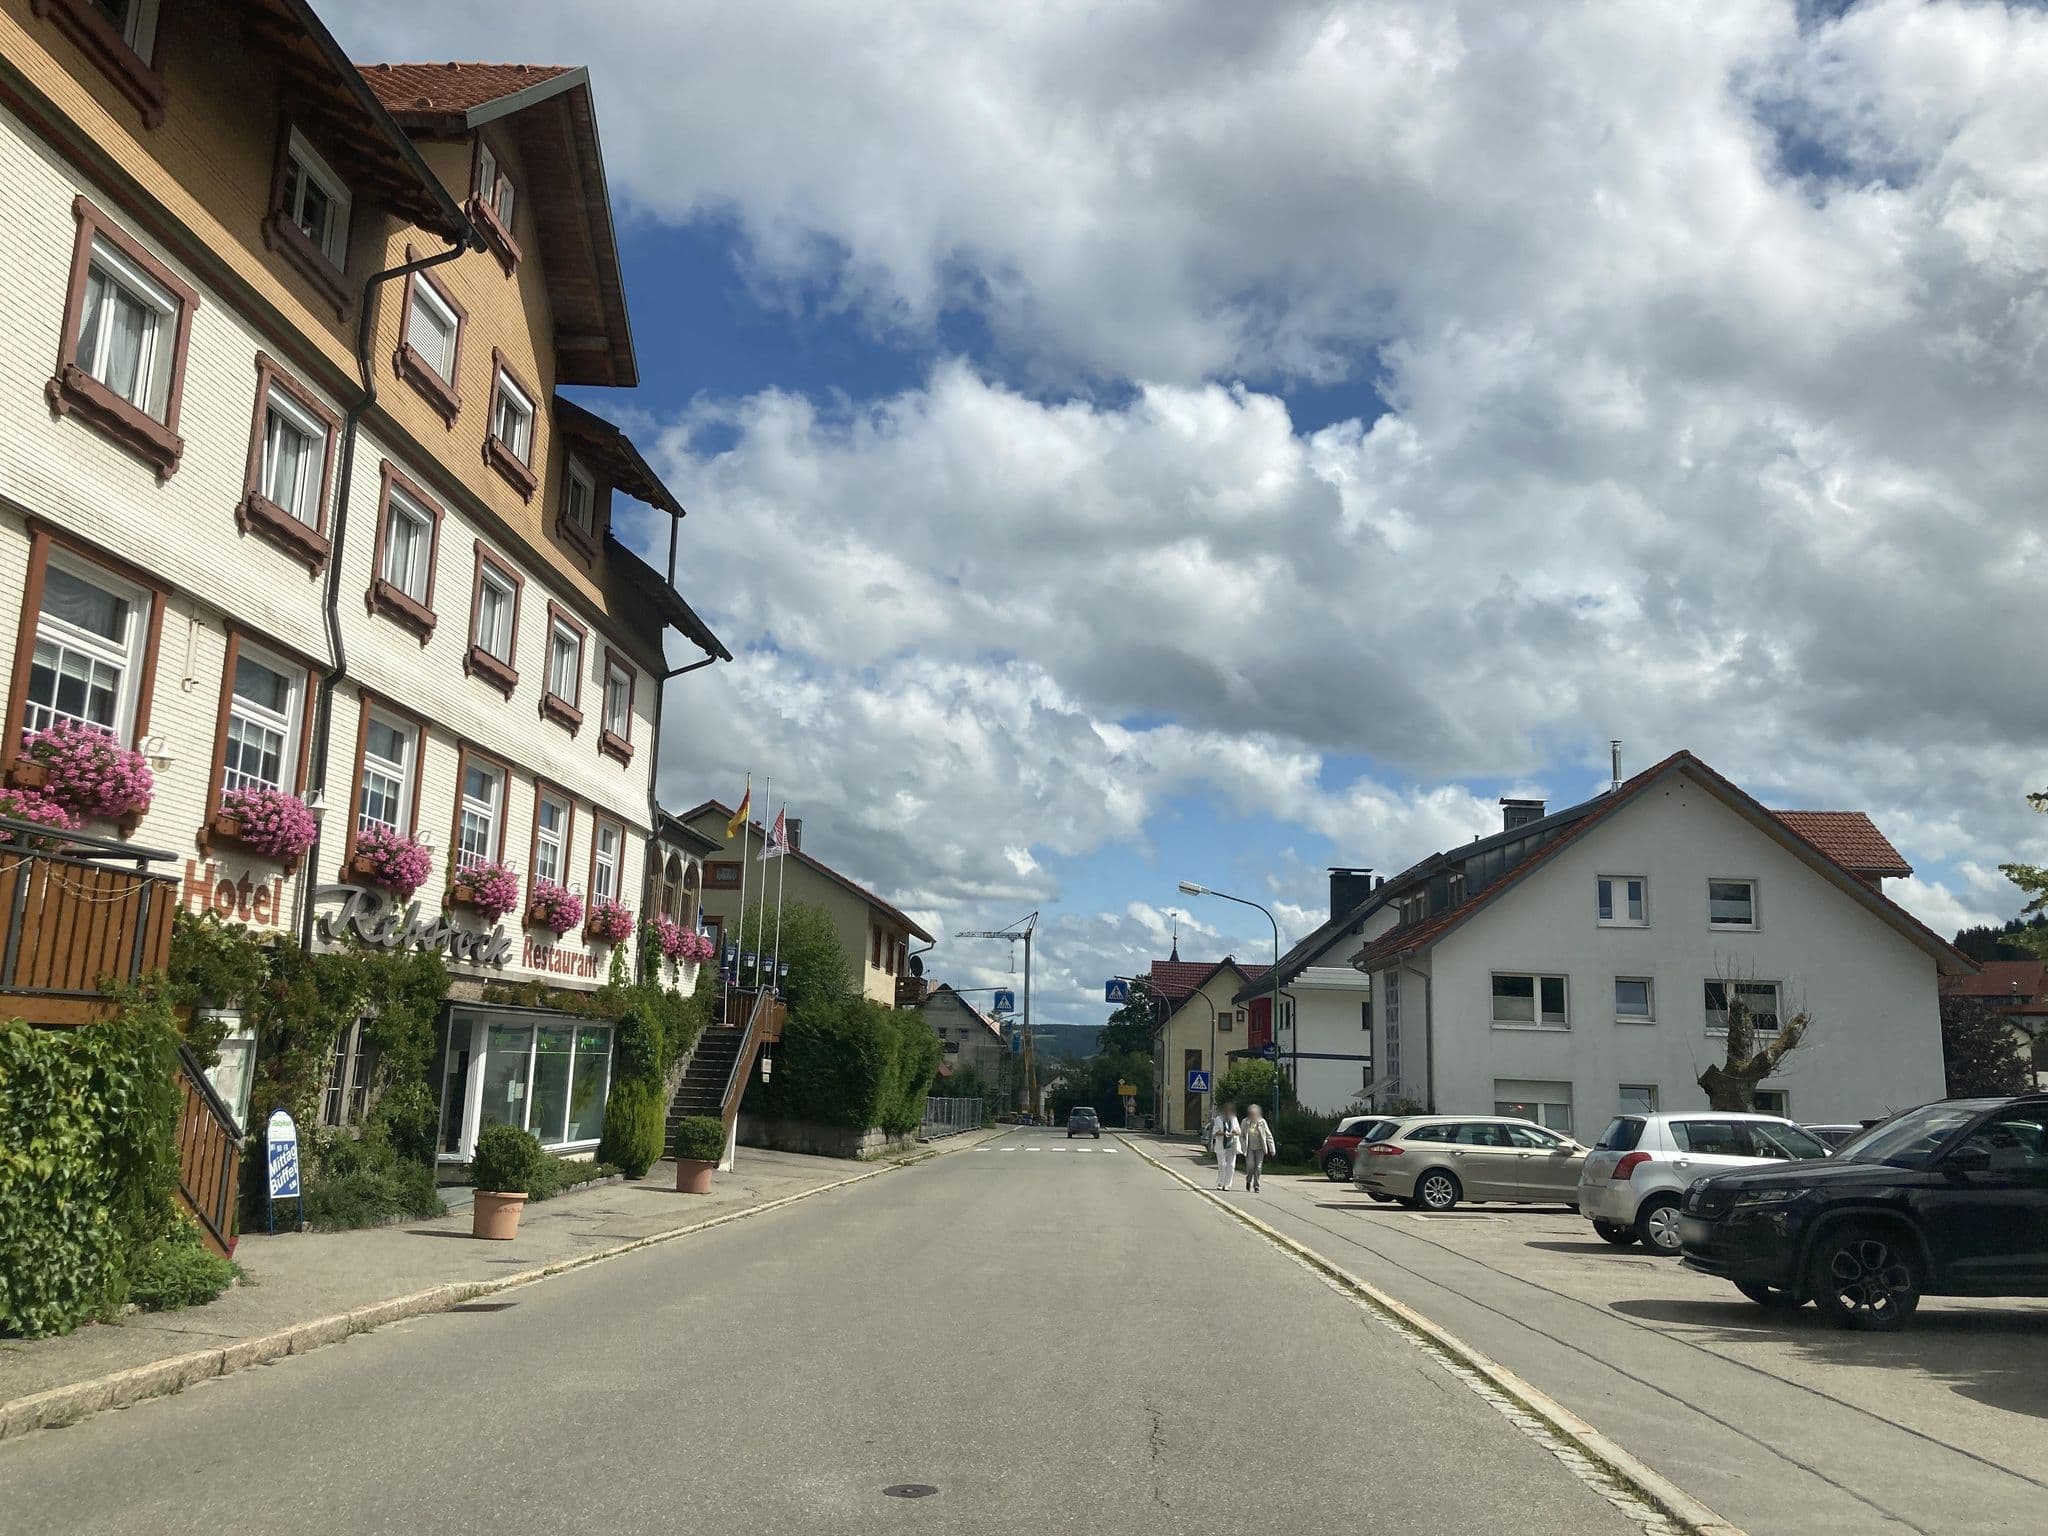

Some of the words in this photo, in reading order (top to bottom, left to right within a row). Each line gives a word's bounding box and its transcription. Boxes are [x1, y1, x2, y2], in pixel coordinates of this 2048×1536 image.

[183, 859, 283, 926] Hotel
[522, 935, 599, 978] Restaurant
[269, 1145, 297, 1178] Mittag
